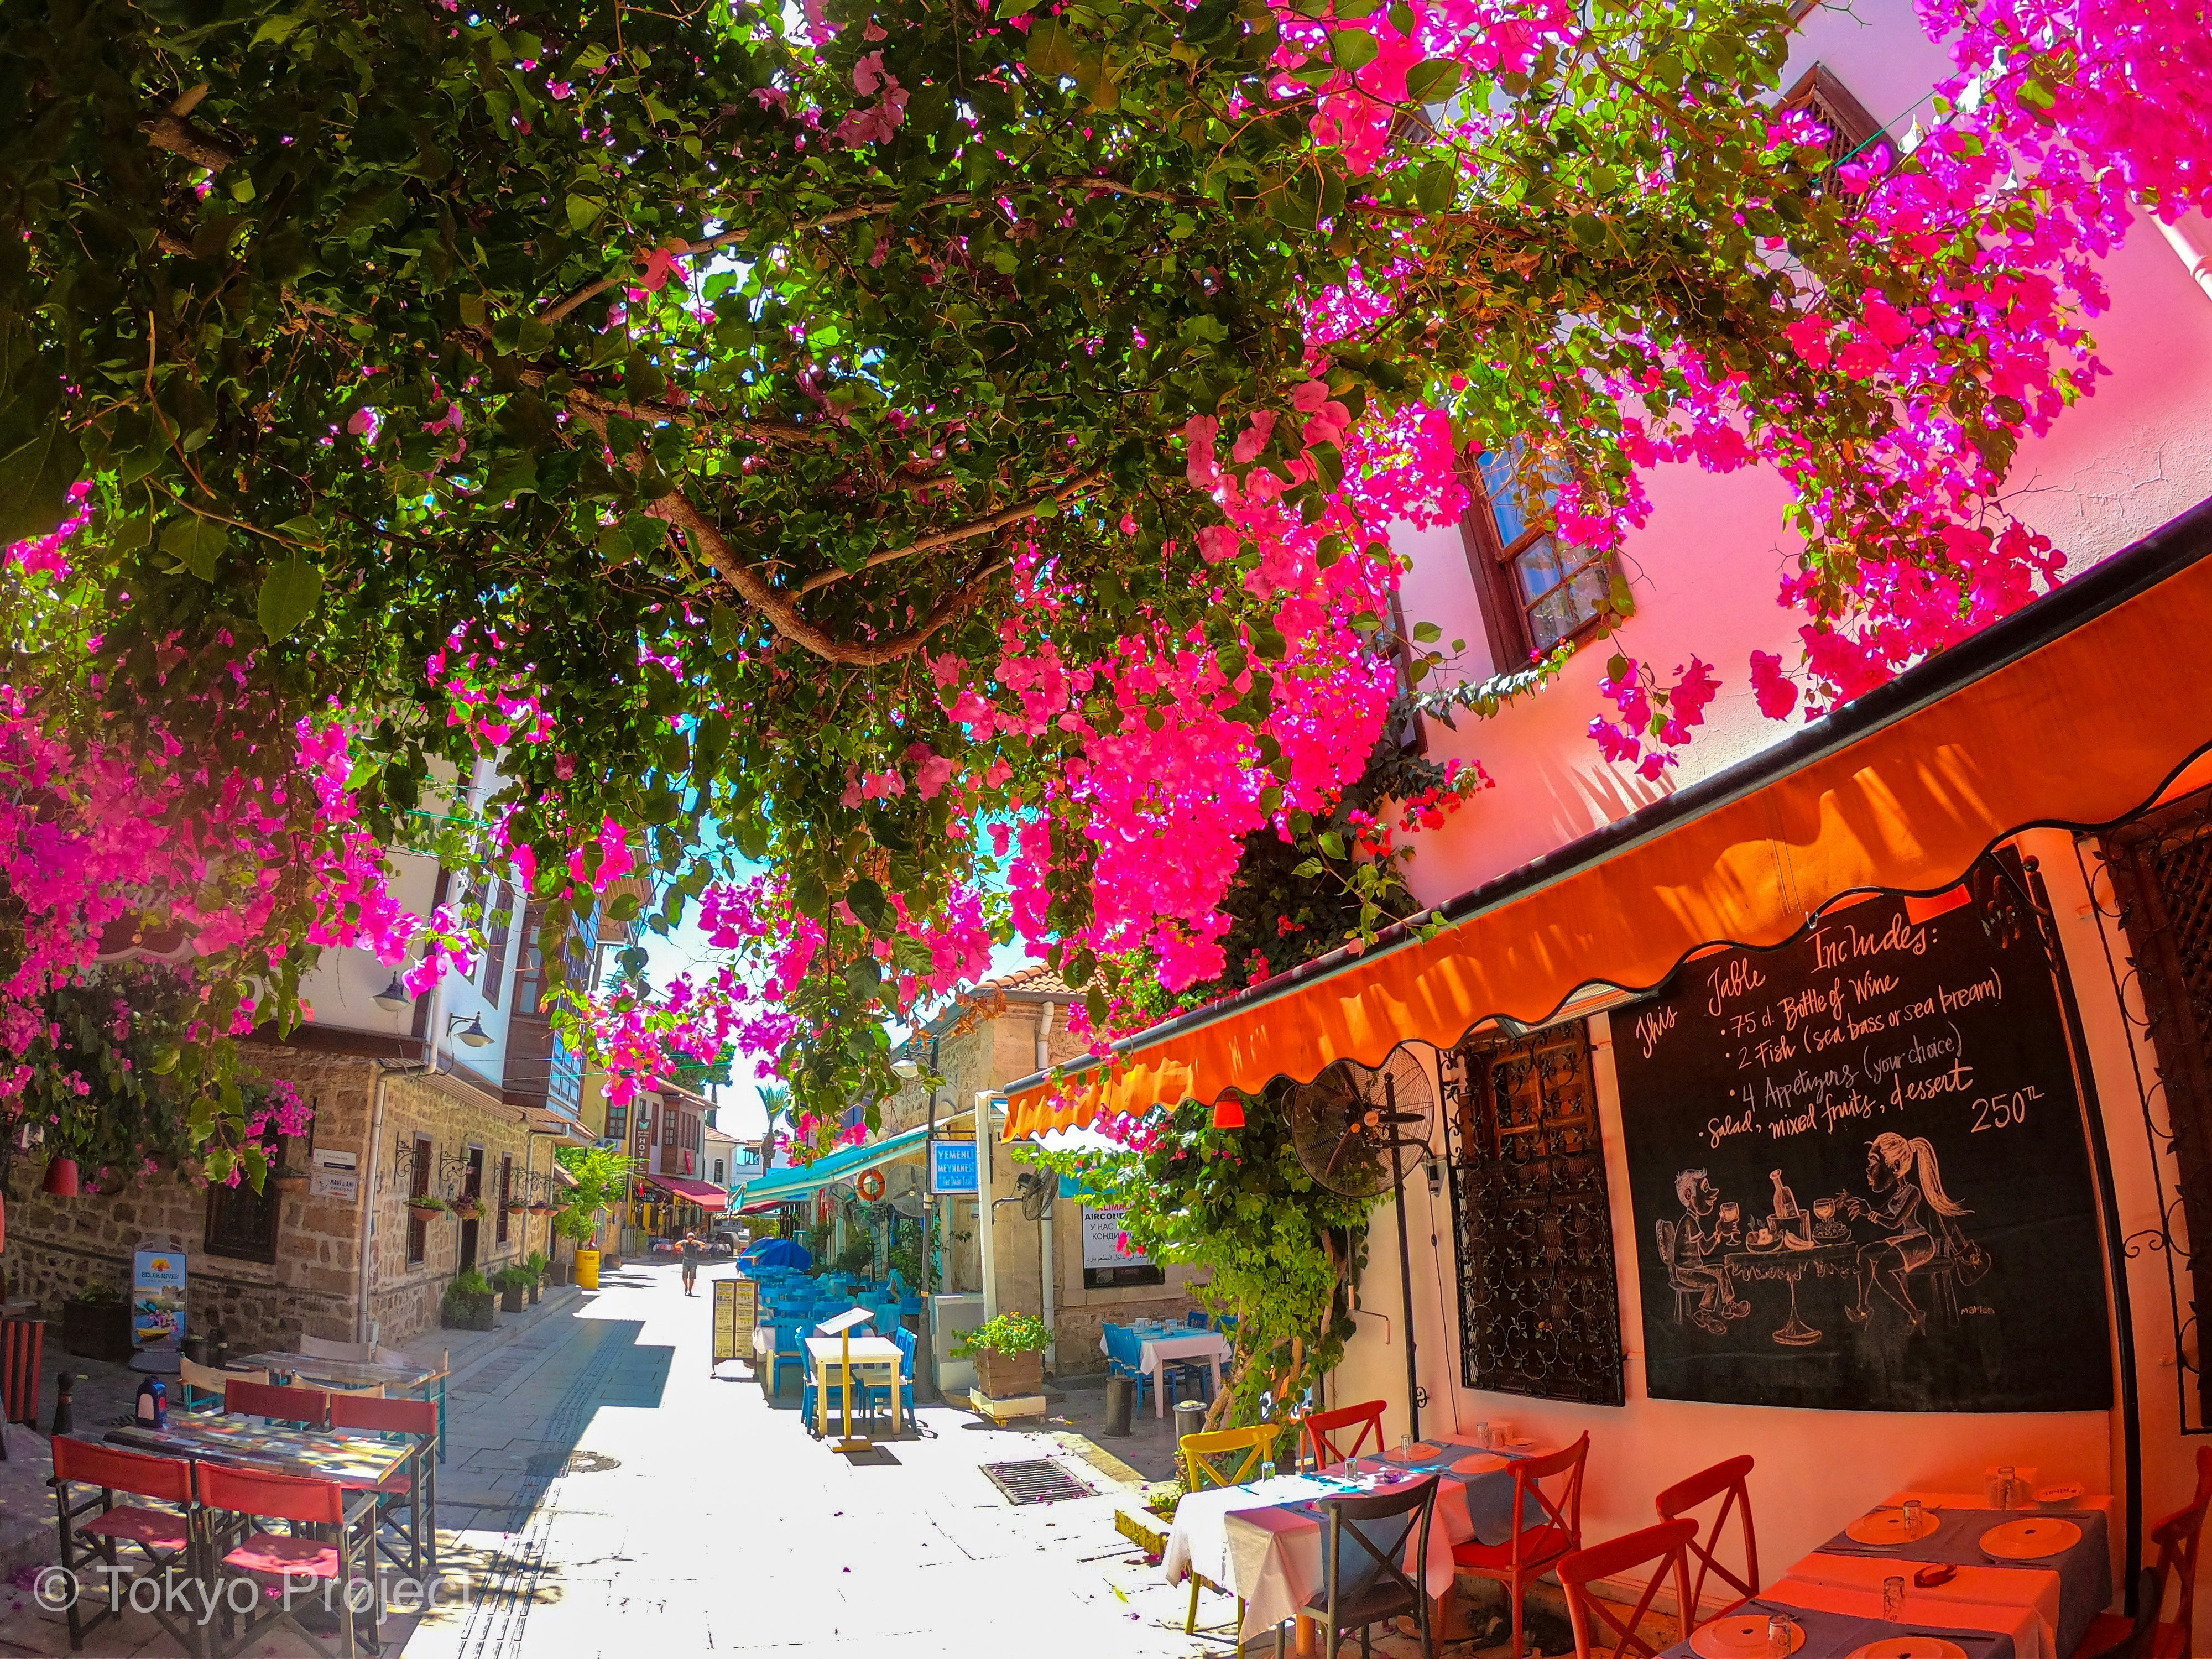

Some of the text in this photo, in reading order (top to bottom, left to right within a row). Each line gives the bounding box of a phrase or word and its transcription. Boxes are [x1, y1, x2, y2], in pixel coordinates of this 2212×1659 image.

[1636, 912, 1938, 1058] This Table Includes:
[1729, 1011, 1756, 1037] 75
[1777, 989, 1827, 1031] Bottle
[1829, 977, 1845, 1021] of
[1848, 970, 1900, 1004] Wine
[1738, 967, 2002, 1070] 2 Fish (sea bass or sea bream)
[1743, 1021, 1962, 1112] 4 Appetizers (your choice)
[1768, 1103, 1818, 1139] mixed
[1820, 1088, 1885, 1134] fruits,
[1890, 1057, 1974, 1110] dessert
[638, 1138, 646, 1171] HOTEL
[937, 1162, 974, 1173] MEYHANESİ
[938, 1149, 974, 1160] YEMENLİ
[1092, 1232, 1134, 1241] КОНДИИ
